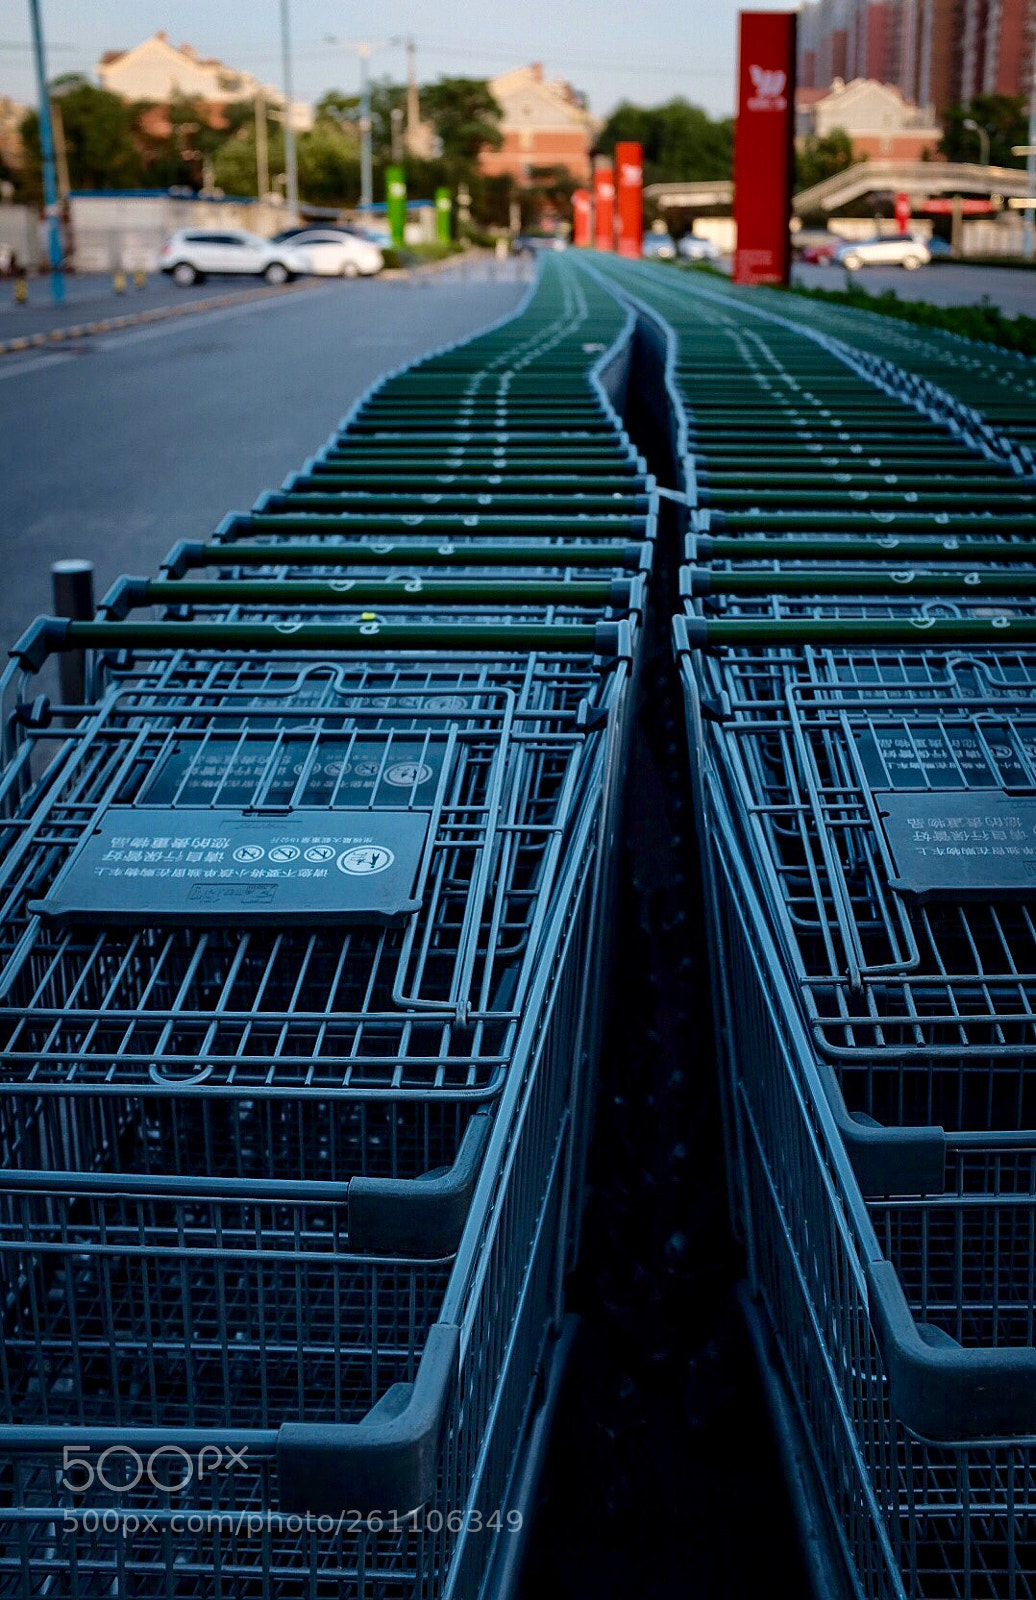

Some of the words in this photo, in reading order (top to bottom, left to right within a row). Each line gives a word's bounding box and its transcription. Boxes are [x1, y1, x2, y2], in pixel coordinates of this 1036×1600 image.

[907, 817, 1022, 829] 您的贵重物品
[913, 830, 1028, 842] 请自行保管好
[110, 837, 232, 849] 您的贵重物品
[101, 850, 225, 863] 请自行保管好
[94, 867, 328, 879] 请您不要将小孩单独留在购物车上
